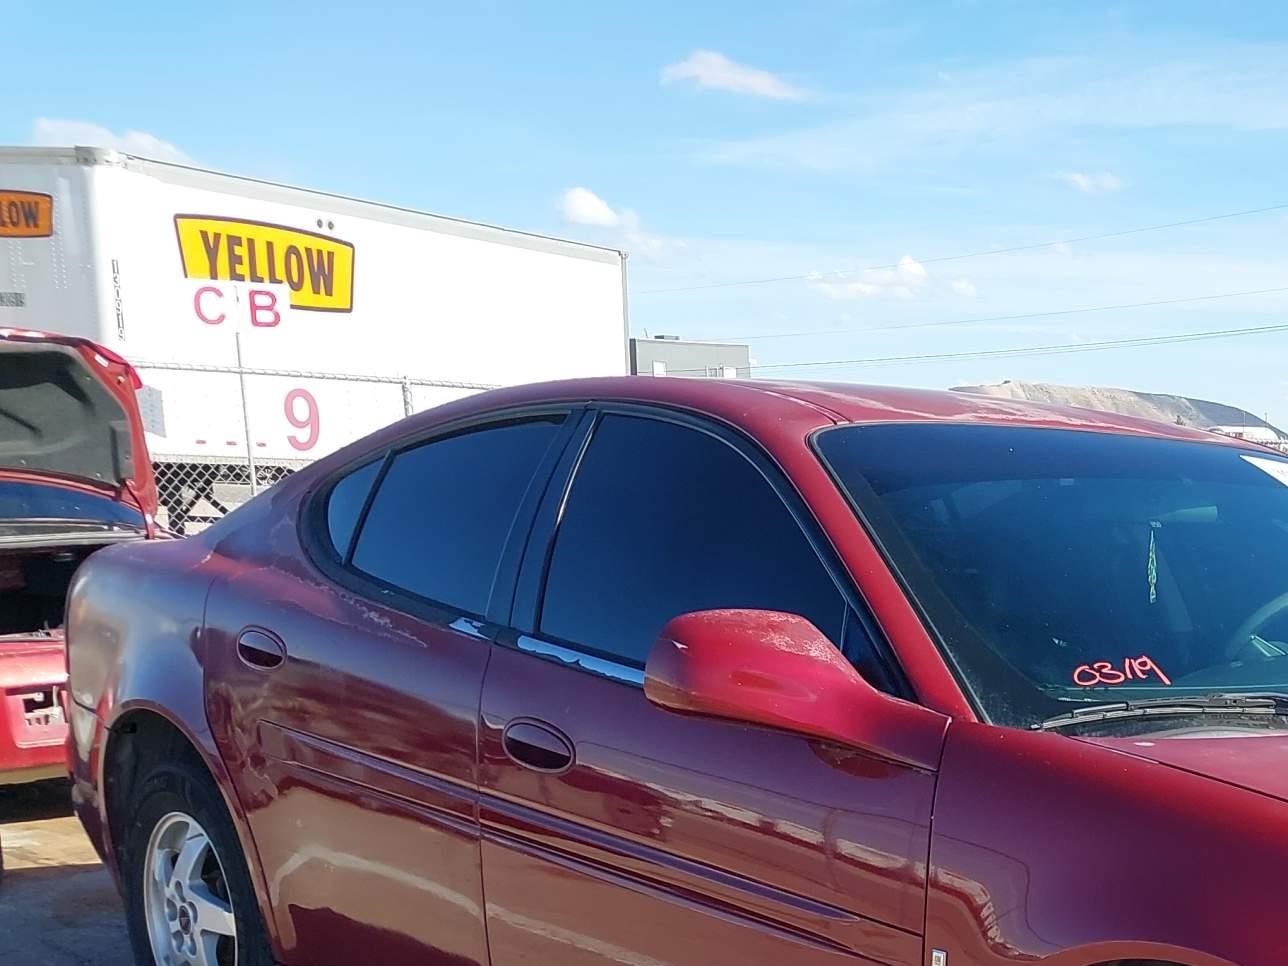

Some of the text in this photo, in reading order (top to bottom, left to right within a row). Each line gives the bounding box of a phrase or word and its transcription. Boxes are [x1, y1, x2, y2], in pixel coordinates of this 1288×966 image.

[200, 230, 334, 297] YELLOW
[193, 286, 281, 328] C B
[283, 387, 320, 451] 9
